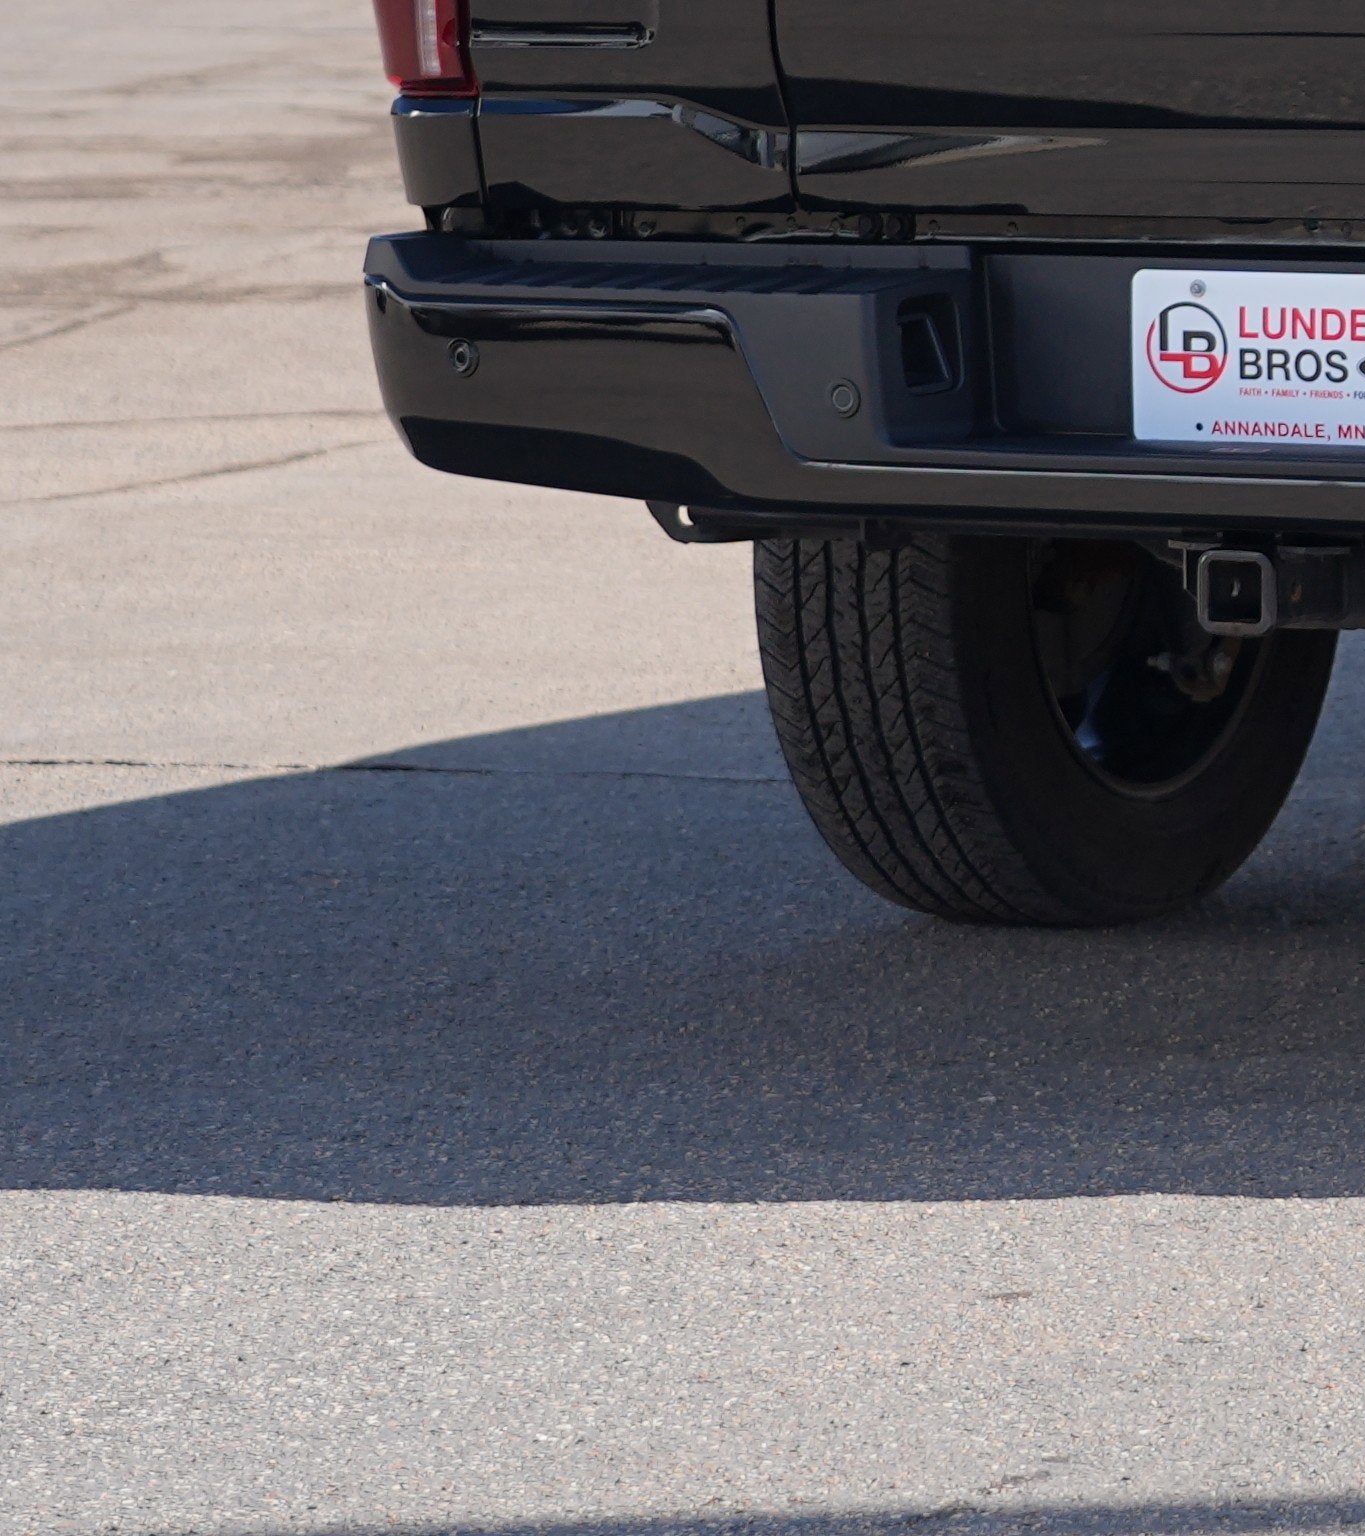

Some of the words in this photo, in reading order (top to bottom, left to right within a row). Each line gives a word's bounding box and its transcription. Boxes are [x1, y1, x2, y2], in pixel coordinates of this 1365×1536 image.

[1238, 348, 1349, 383] BROS
[1239, 388, 1262, 396] FAITH
[1271, 388, 1301, 398] FAMILY
[1309, 389, 1344, 400] FRIENDS
[1210, 420, 1332, 442] ANNANDALE,
